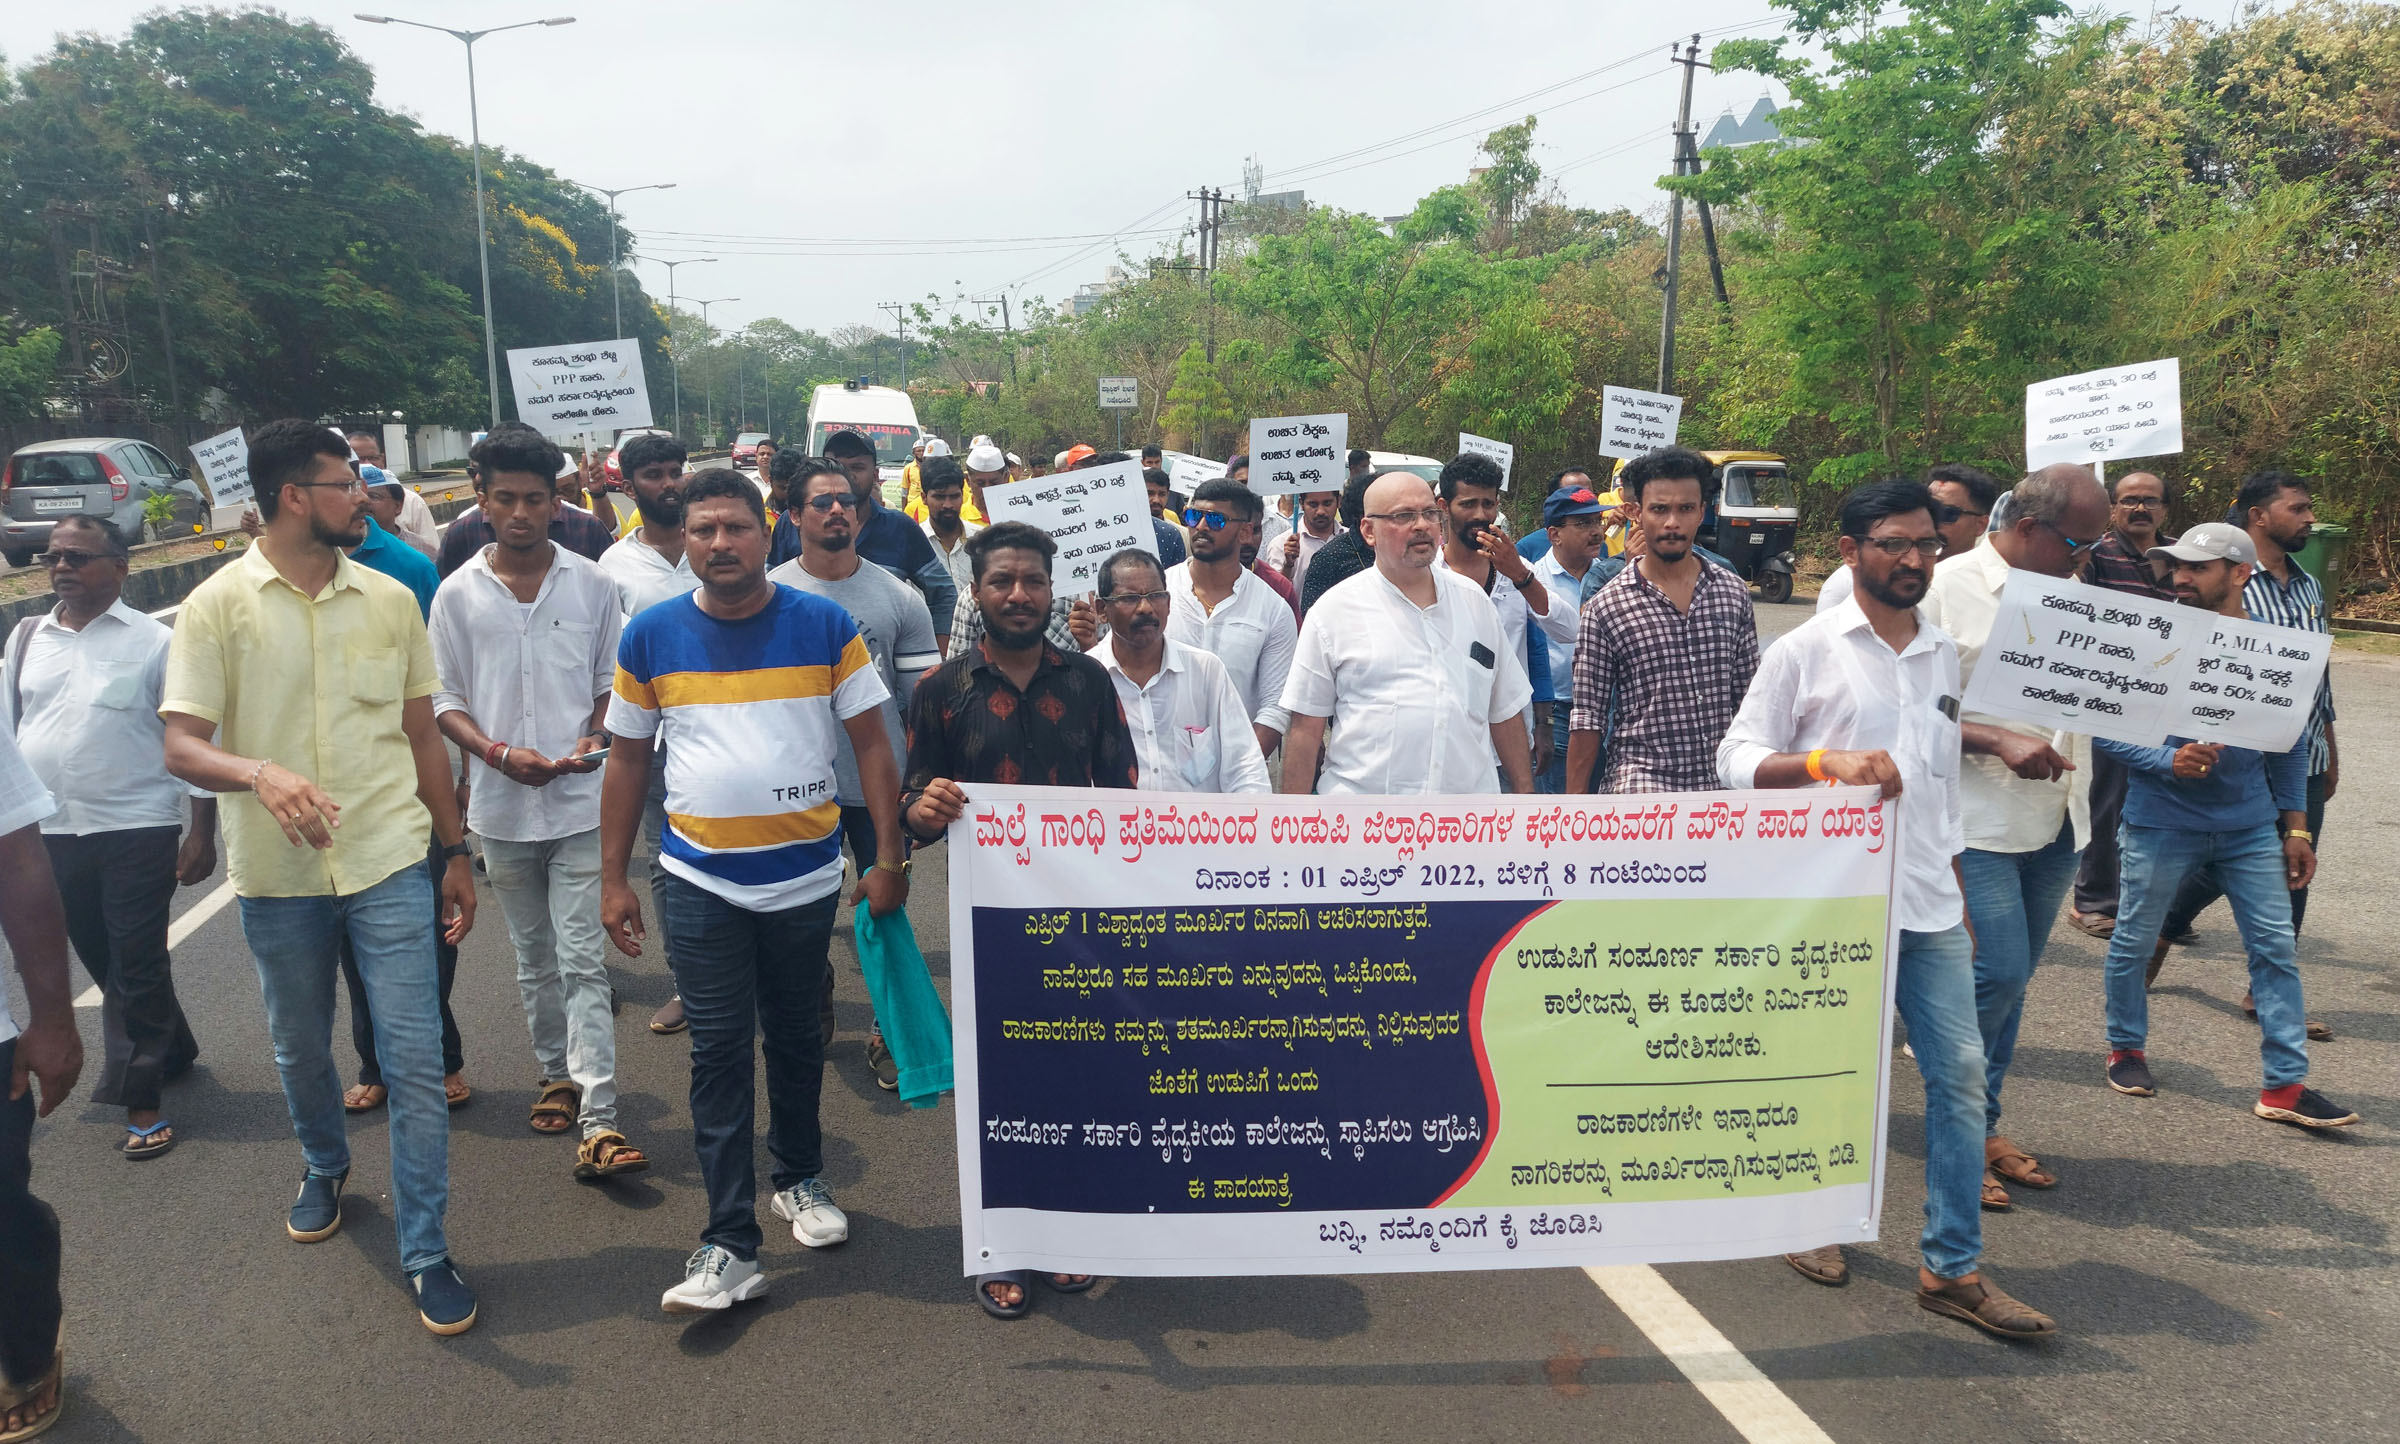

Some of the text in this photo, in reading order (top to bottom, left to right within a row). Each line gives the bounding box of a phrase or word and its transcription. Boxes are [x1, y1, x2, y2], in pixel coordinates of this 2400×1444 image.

[532, 351, 618, 367] ಕೂಸಮ್ಮ ಶಂಭು ಶೆಟ್ಟಿ
[552, 373, 576, 385] PPP
[2121, 373, 2137, 383] 30
[527, 393, 555, 405] ನಮಗೆ
[2137, 401, 2153, 410] 50
[1268, 426, 1298, 438] ಉಚಿತ
[1261, 446, 1335, 460] ಉಚಿತ ಆರೋಗ್ಯ
[1272, 471, 1295, 484] ನಮ್ಮ
[1008, 495, 1033, 506] ನಮ್ಮ
[1065, 483, 1088, 496] ನಮ್ಮ
[1090, 478, 1107, 490] 30
[1113, 513, 1129, 526] 50
[1063, 547, 1083, 560] ಇದು
[1086, 541, 1111, 554] ಯಾವ
[2042, 594, 2173, 639] ಕೂಸಮ್ಮ ಶಂಭು ಶೆಟ್ಟಿ
[2056, 630, 2136, 661] PPP ಸಾಕು,
[2210, 631, 2227, 649] P,
[2232, 636, 2277, 655] MLA
[2000, 651, 2044, 670] ನಮಗೆ
[2225, 662, 2254, 681] ನಿಮ್ಮ
[2022, 686, 2124, 715] ಕಾಲೇಜೇ ಬೇಕು.
[2224, 685, 2257, 701] 50%
[2192, 705, 2235, 721] ಯಾಕೆ?
[772, 780, 826, 801] TRIPR
[976, 802, 1031, 866] ಮಲ್ಪೆ
[1041, 806, 1107, 855] ಗಾಂಧಿ
[1119, 805, 1258, 863] ಪ್ರತಿಮೆಯಿಂದ
[1271, 811, 1350, 845] ಉಡುಪಿ
[1364, 807, 1515, 862] ಜಿಲ್ಲಾಧಿಕಾರಿಗಳ
[1687, 801, 1748, 841] ಮೌನ
[1757, 801, 1813, 839] ಪಾದ
[1195, 865, 1271, 892] ದಿನಾಂಕ
[1301, 866, 1327, 888] 01
[1339, 864, 1407, 897] ಎಪ್ರಿಲ್
[1419, 864, 1485, 888] 2022,
[1496, 860, 1554, 897] ಬೆಳಿಗ್ಗೆ
[1563, 863, 1577, 885] 8
[1590, 859, 1707, 885] ಗಂಟೆಯಿಂದ
[1024, 902, 1432, 949] ಎಪ್ರಿಲ್ 1 ವಿಶ್ವಾದ್ಯಂತ ಮೂರ್ಖರ ದಿನವಾಗಿ ಆಚರಿಸಲಾಗುತ್ತದೆ.
[1517, 936, 1873, 979] ಉಡುಪಿಗೆ ಸಂಪೂರ್ಣ ಸರ್ಕಾರಿ ವೈದ್ಯಕೀಯ
[1042, 957, 1418, 999] ನಾವೆಲ್ಲರೂ ಸಹ ಮೂರ್ಖರು ಎನ್ನುವುದನ್ನು ಒಪ್ಪಿಕೊಂಡು,
[1544, 984, 1849, 1028] ಕಾಲೇಜನ್ನು ಈ ಕೂಡಲೇ ನಿರ್ಮಿಸಲು
[1002, 1010, 1460, 1056] ರಾಜಕಾರಣಿಗಳು ನಮ್ಮನ್ನು ಶತಮೂರ್ಖರನ್ನಾಗಿಸುವುದನ್ನು ನಿಲ್ಲಿಸುವುದರ
[1645, 1031, 1767, 1060] ಆದೇಶಿಸಬೇಕು.
[1149, 1067, 1319, 1094] ಜೊತೆಗೆ ಉಡುಪಿಗೆ ಒಂದು
[1576, 1102, 1798, 1142] ರಾಜಕಾರಣಿಗಳೇ ಇನ್ನಾದರೂ
[986, 1113, 1480, 1163] ಸಂಪೂರ್ಣ ಸರ್ಕಾರಿ ವೈದ್ಯಕೀಯ ಕಾಲೇಜನ್ನು ಸ್ಥಾಪಿಸಲು ಆಗ್ರಹಿಸಿ
[1511, 1142, 1859, 1197] ನಾಗರಿಕರನ್ನು ಮೂರ್ಖರನ್ನಾಗಿಸುವುದನ್ನು ಬಿಡಿ.
[1188, 1176, 1206, 1199] ಈ
[1319, 1212, 1603, 1254] ಬನ್ನಿ, ನಮ್ಮೊಂದಿಗೆ ಕೈ ಜೊಡಿಸಿ
